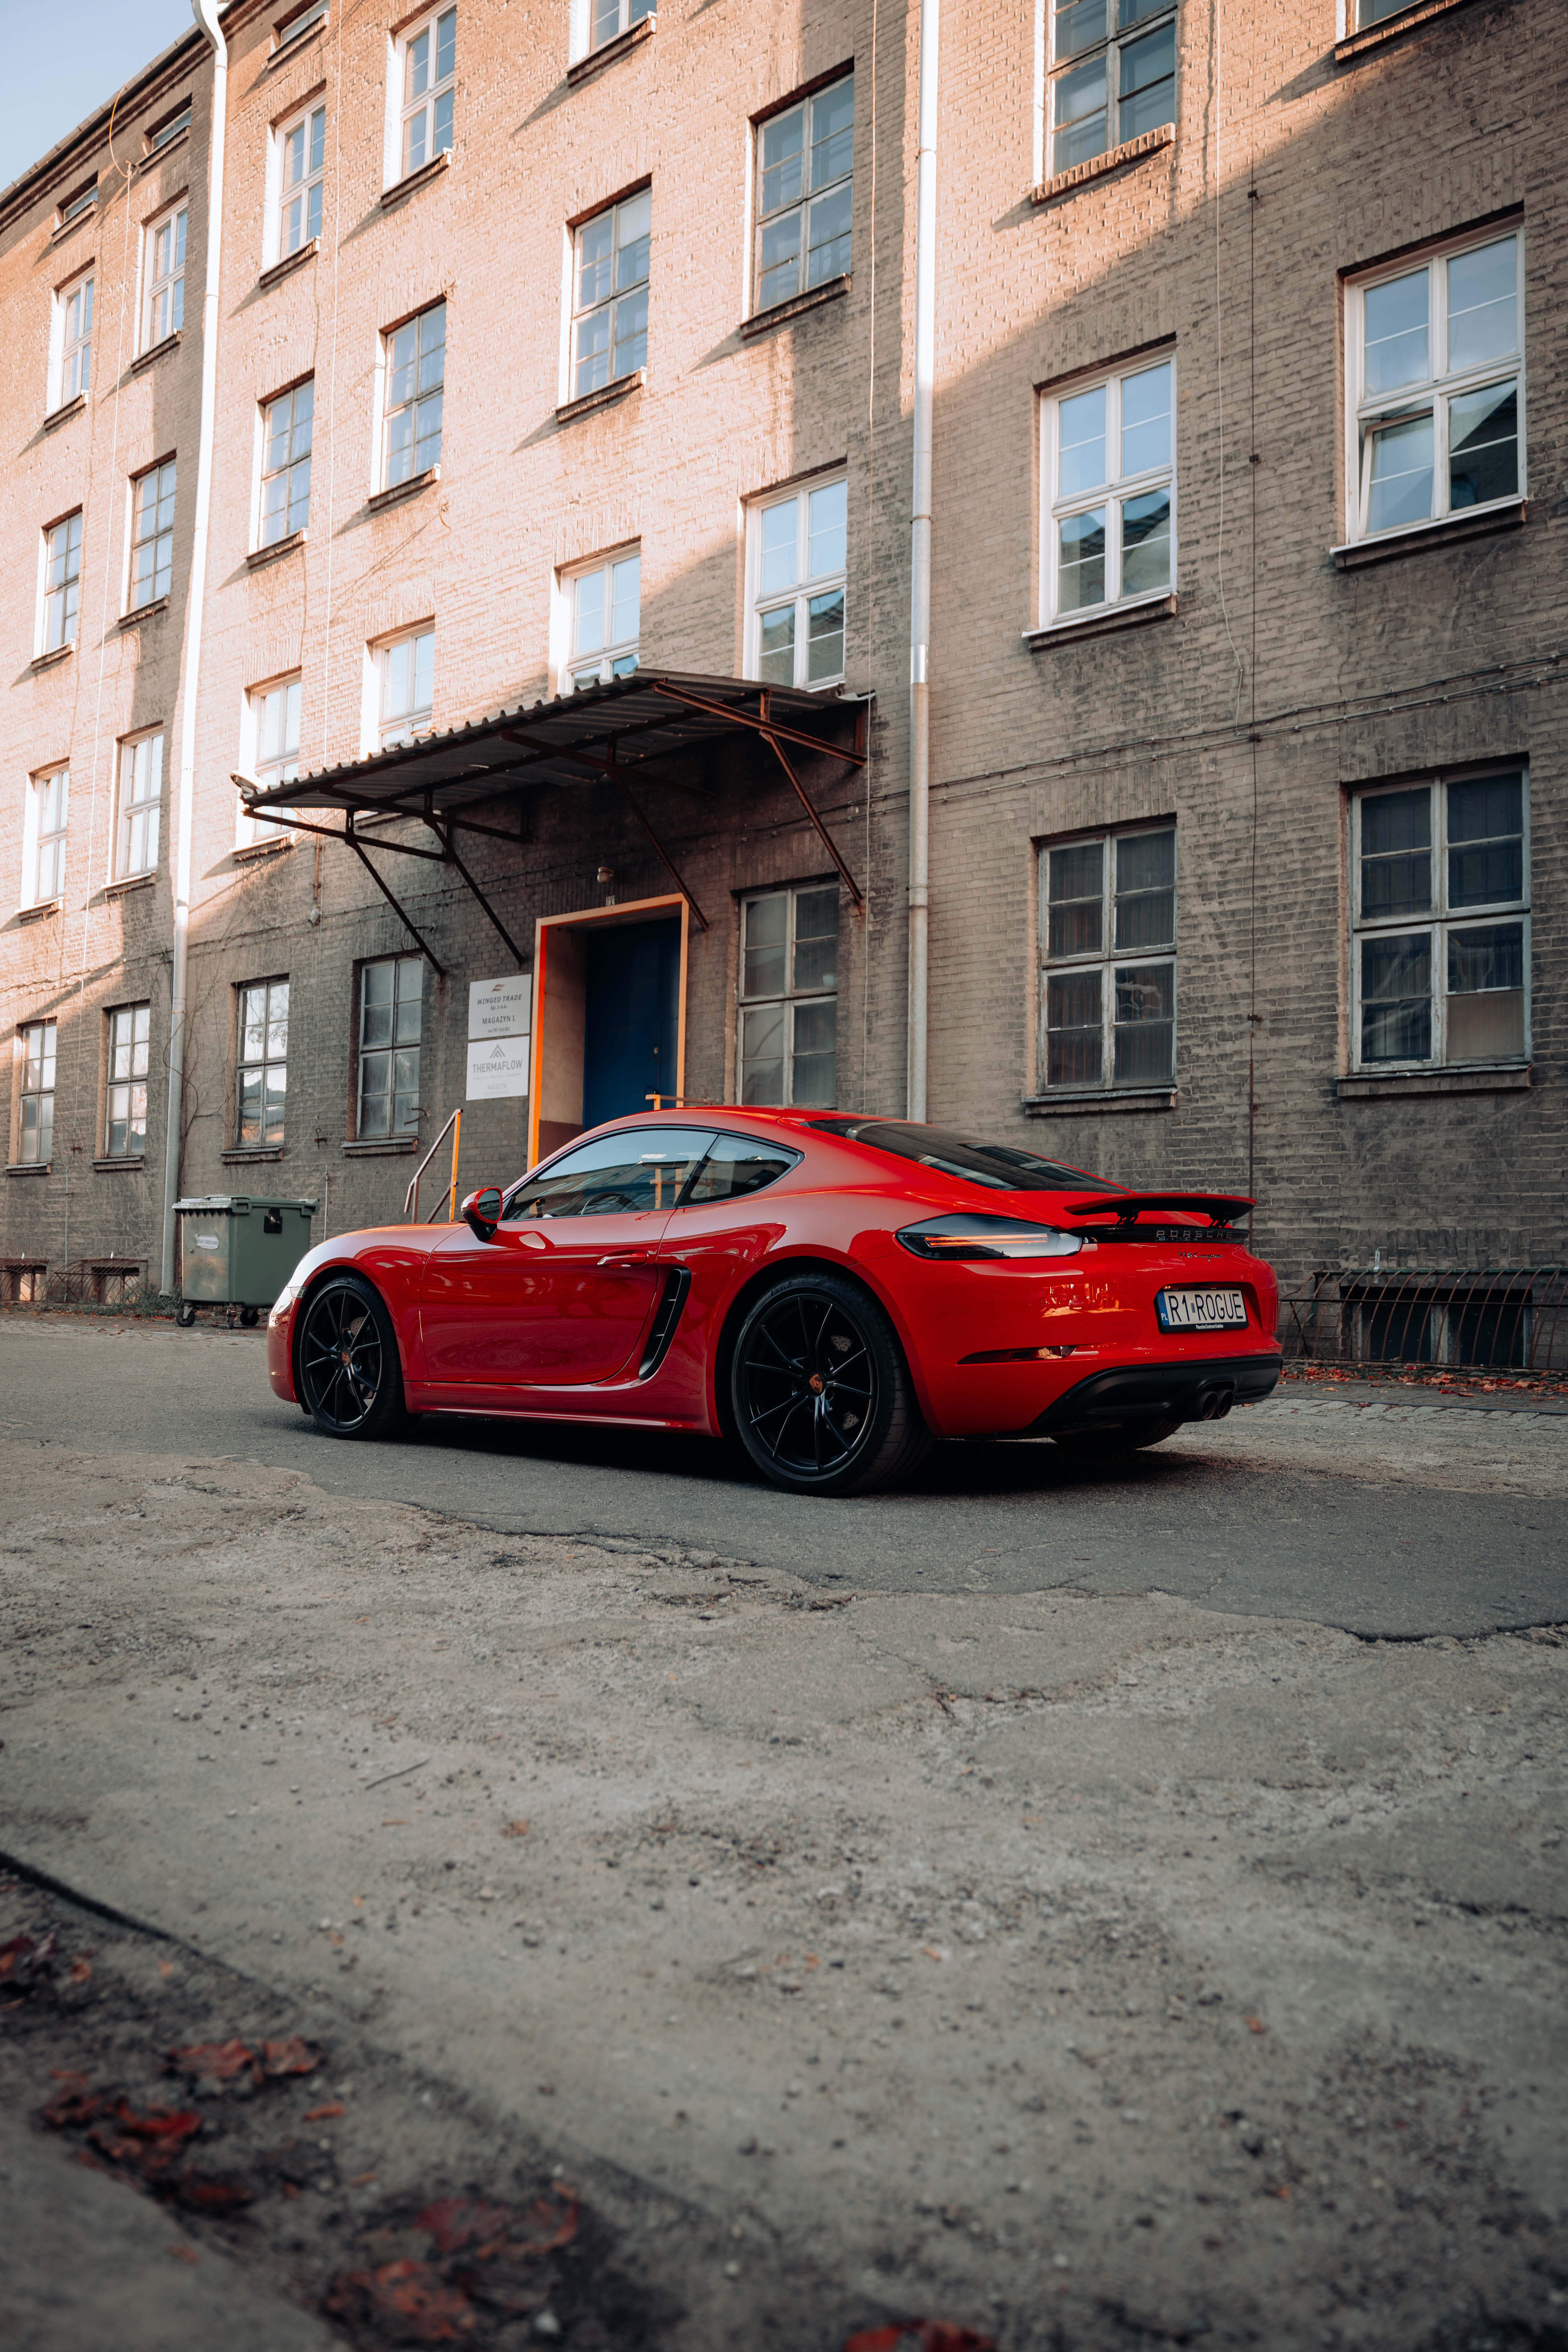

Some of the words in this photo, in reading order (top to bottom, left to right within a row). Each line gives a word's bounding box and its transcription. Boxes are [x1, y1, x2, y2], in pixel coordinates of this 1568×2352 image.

[477, 997, 501, 1005] WINGED
[482, 1015, 511, 1024] MAGAZYN
[473, 1059, 522, 1073] THERMAFLOW
[1156, 1229, 1232, 1238] PORSCHE
[1194, 1252, 1223, 1262] Cayman
[770, 1281, 793, 1297] PIRELLI
[1168, 1294, 1190, 1322] R1
[1194, 1293, 1244, 1321] ROGUE
[1161, 1313, 1168, 1321] PL
